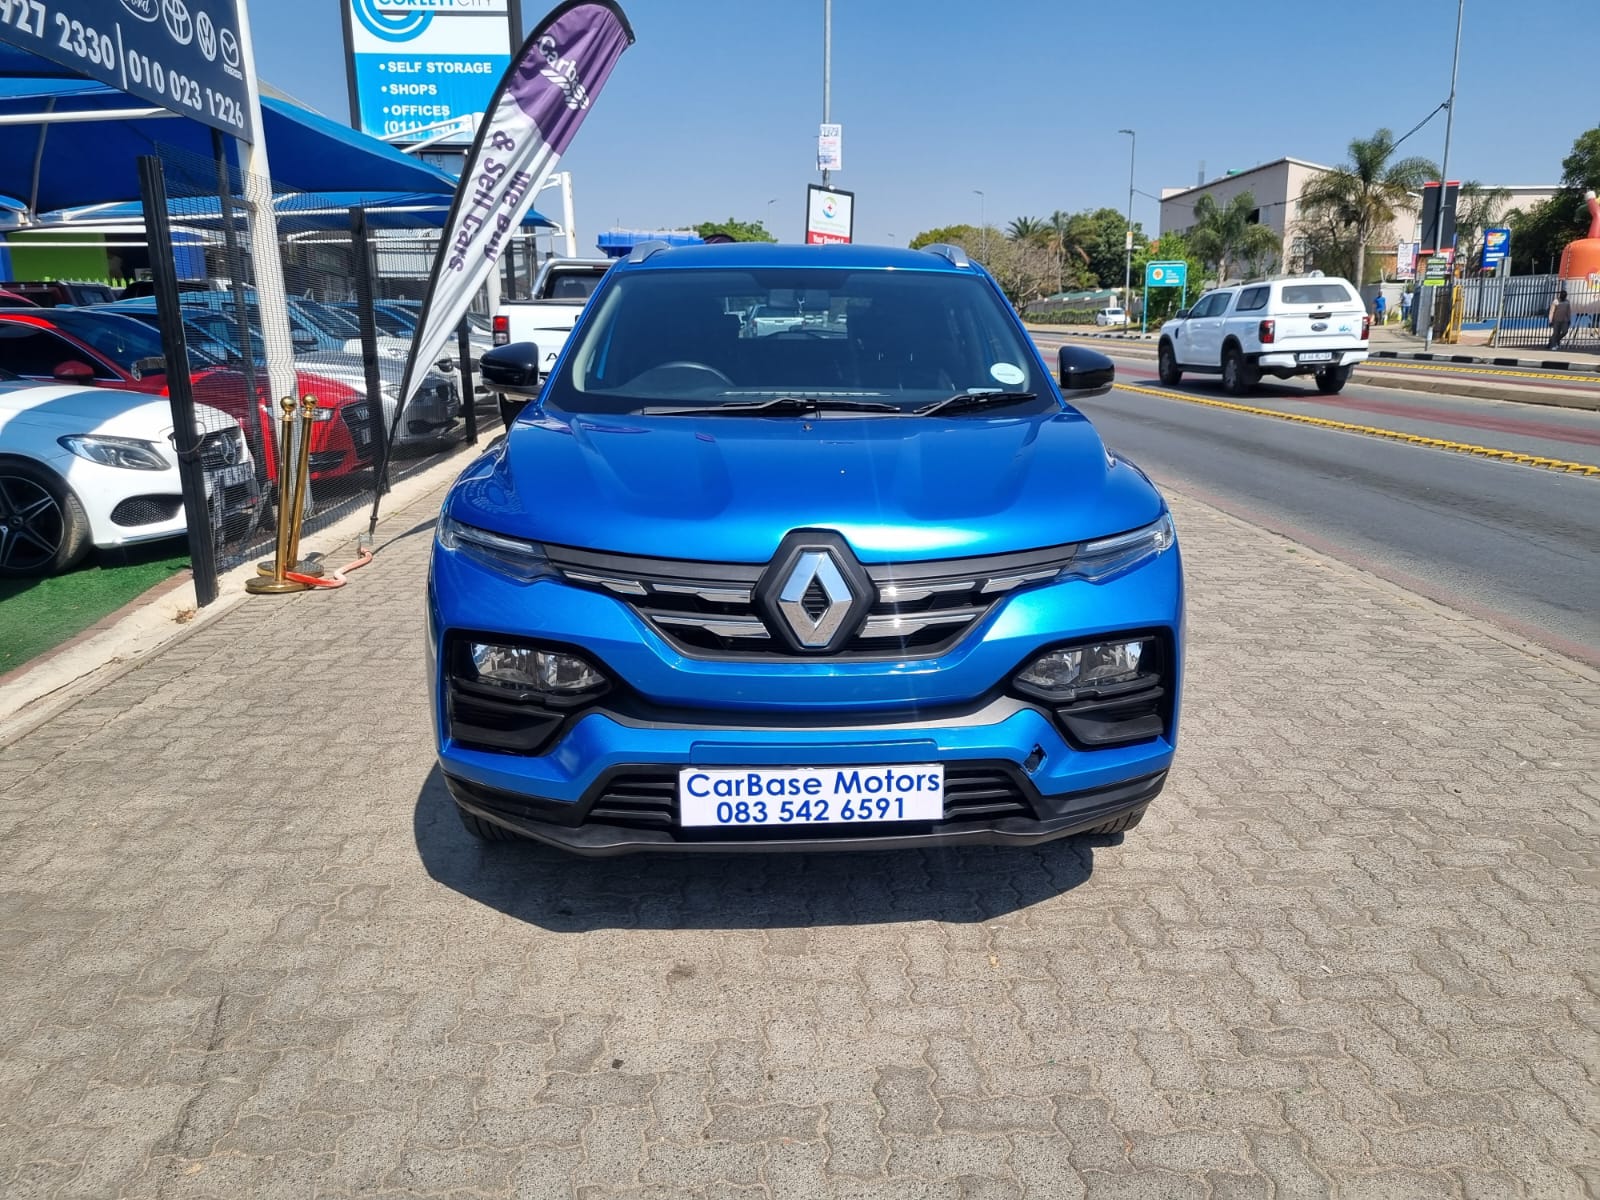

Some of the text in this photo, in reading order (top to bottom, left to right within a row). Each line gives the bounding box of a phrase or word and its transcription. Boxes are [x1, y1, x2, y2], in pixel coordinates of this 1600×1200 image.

[56, 12, 115, 70] 2330
[388, 61, 492, 74] SELF STORAGE
[129, 50, 244, 129] 010 023 1226
[390, 84, 437, 95] SHOPS
[391, 105, 450, 116] OFFICES
[447, 130, 515, 272] & Sell Cars
[484, 170, 531, 263] We Buy
[687, 769, 940, 797] CarBase Motors
[717, 798, 904, 823] 083 542 6591
